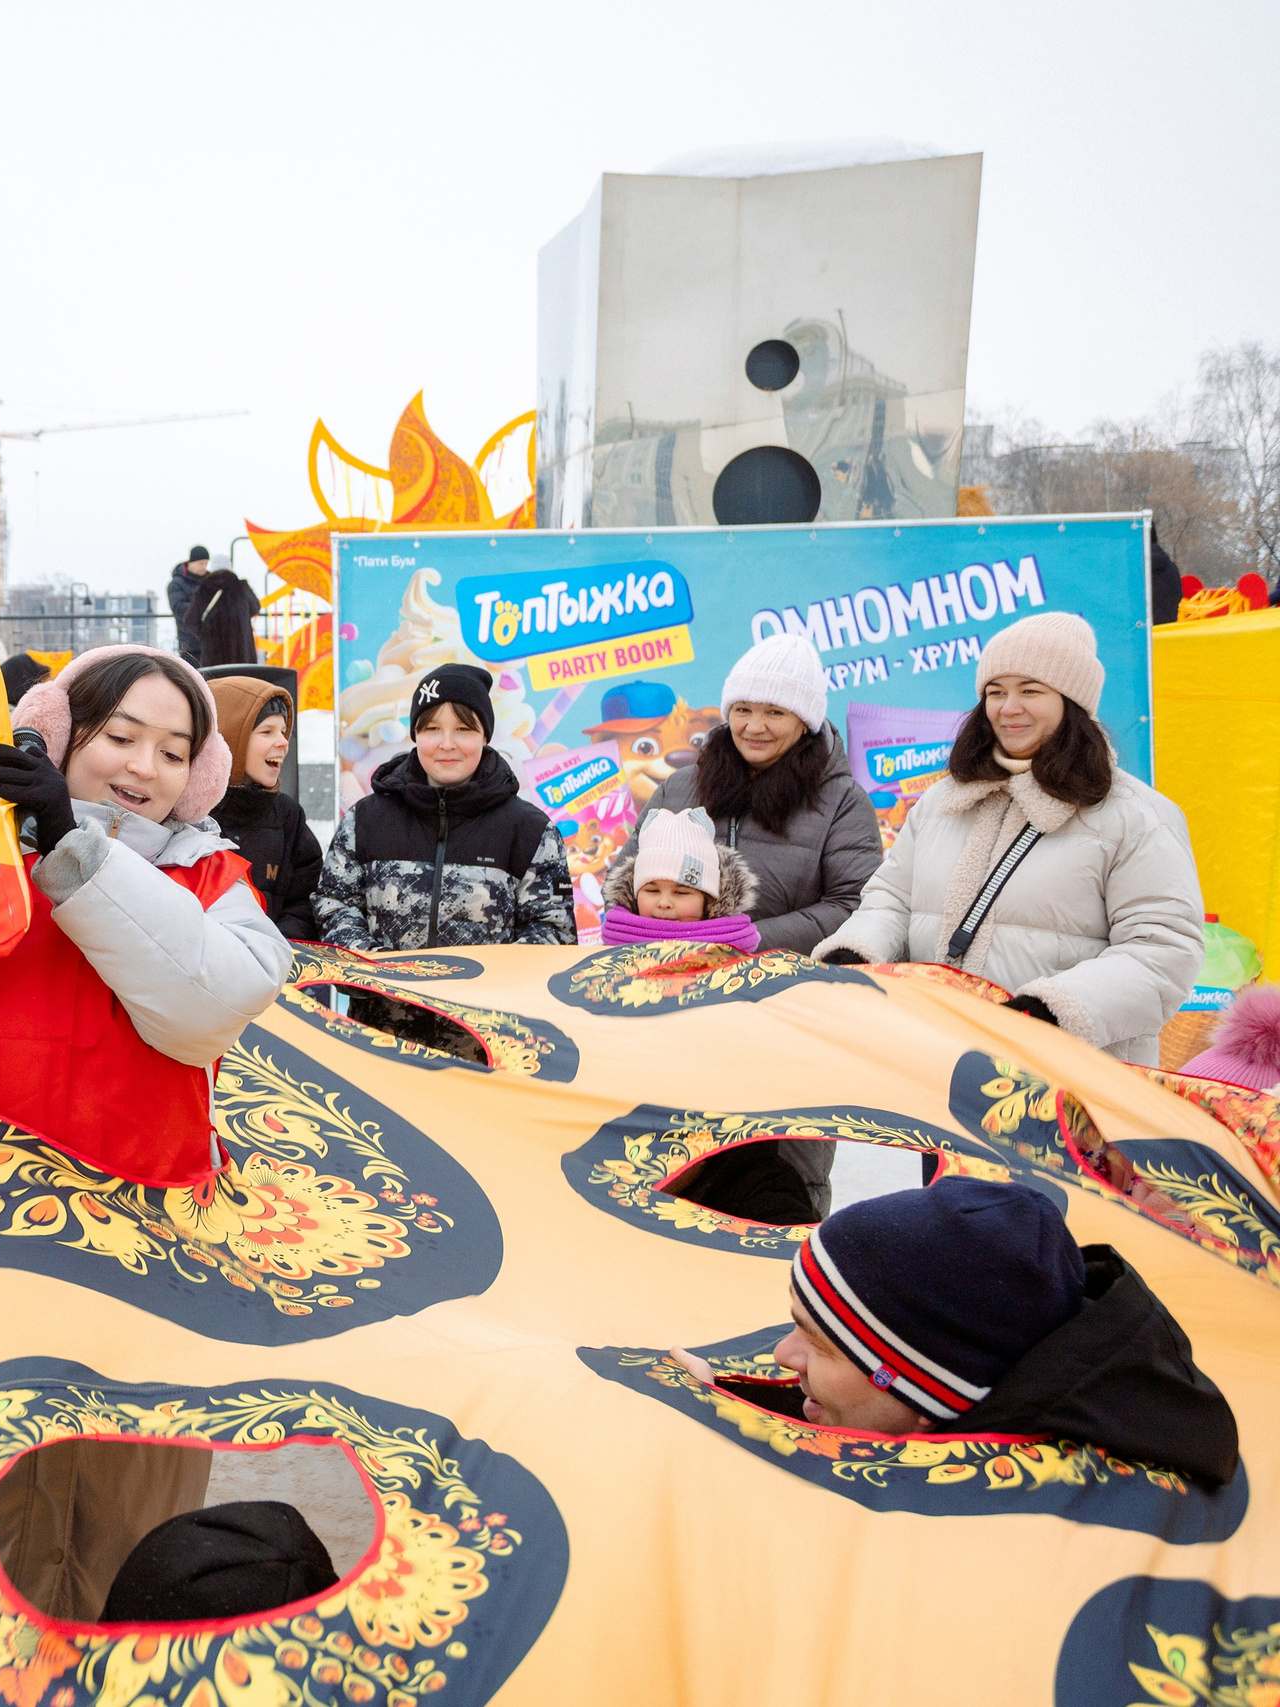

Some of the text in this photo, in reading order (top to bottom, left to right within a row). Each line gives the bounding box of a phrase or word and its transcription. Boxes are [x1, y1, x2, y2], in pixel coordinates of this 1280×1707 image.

[391, 554, 416, 569] Бум
[751, 554, 1046, 652] ОМНОМНОМ
[548, 651, 607, 681] PARTY
[822, 654, 890, 693] ХРУМ
[908, 634, 983, 675] ХРУМ
[418, 679, 440, 705] NY
